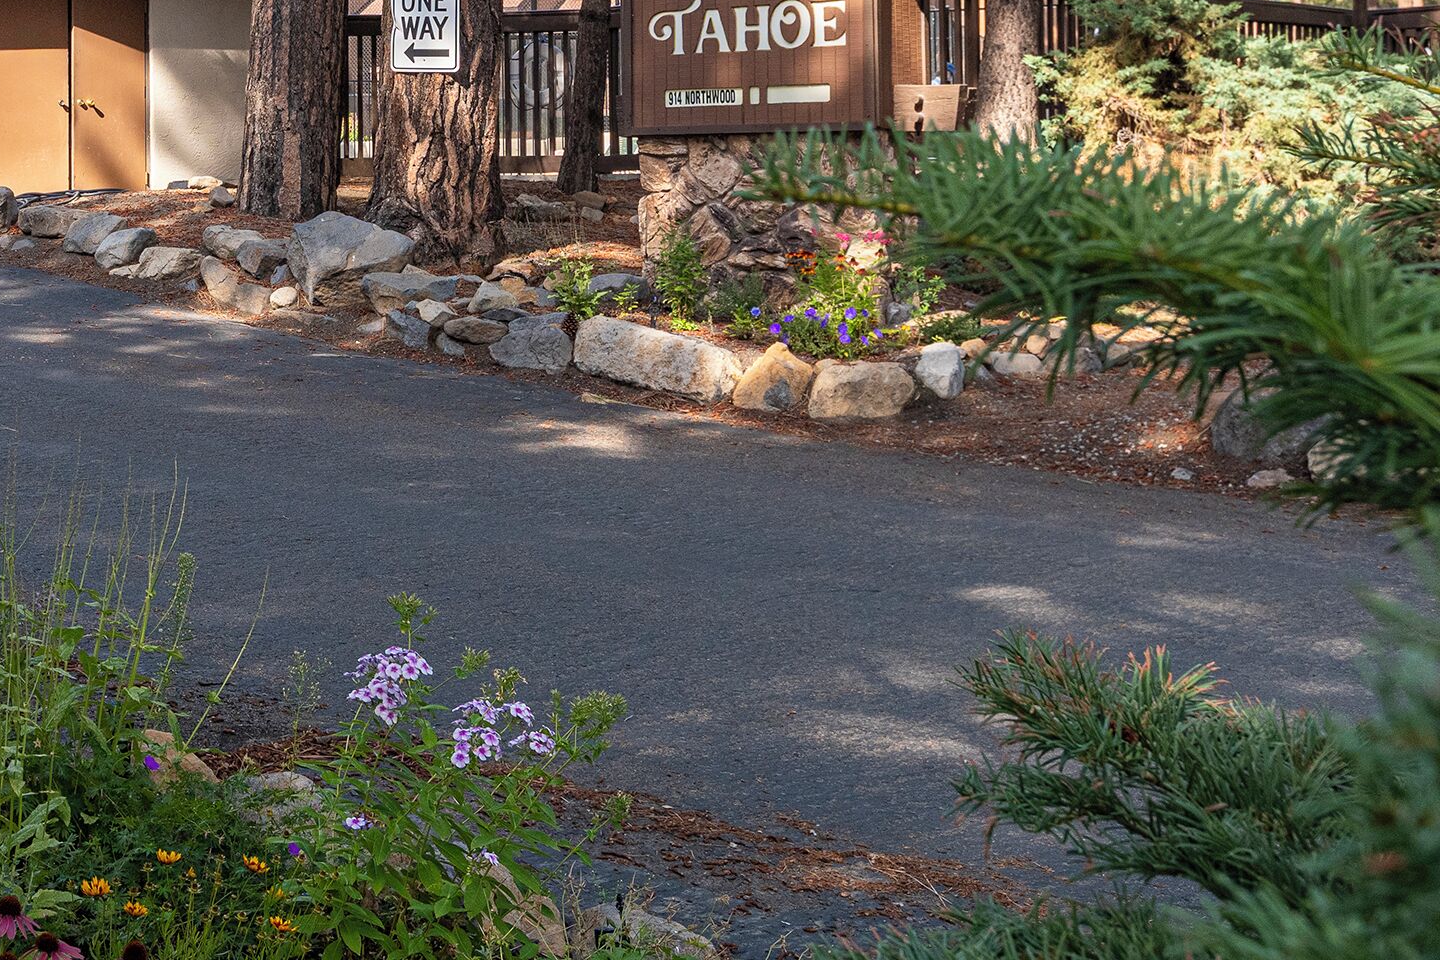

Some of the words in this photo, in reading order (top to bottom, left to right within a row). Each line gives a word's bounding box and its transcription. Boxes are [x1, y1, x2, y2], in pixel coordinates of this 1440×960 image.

[400, 16, 449, 40] WAY
[668, 91, 682, 106] 914
[685, 89, 736, 105] NORTHWOOD
